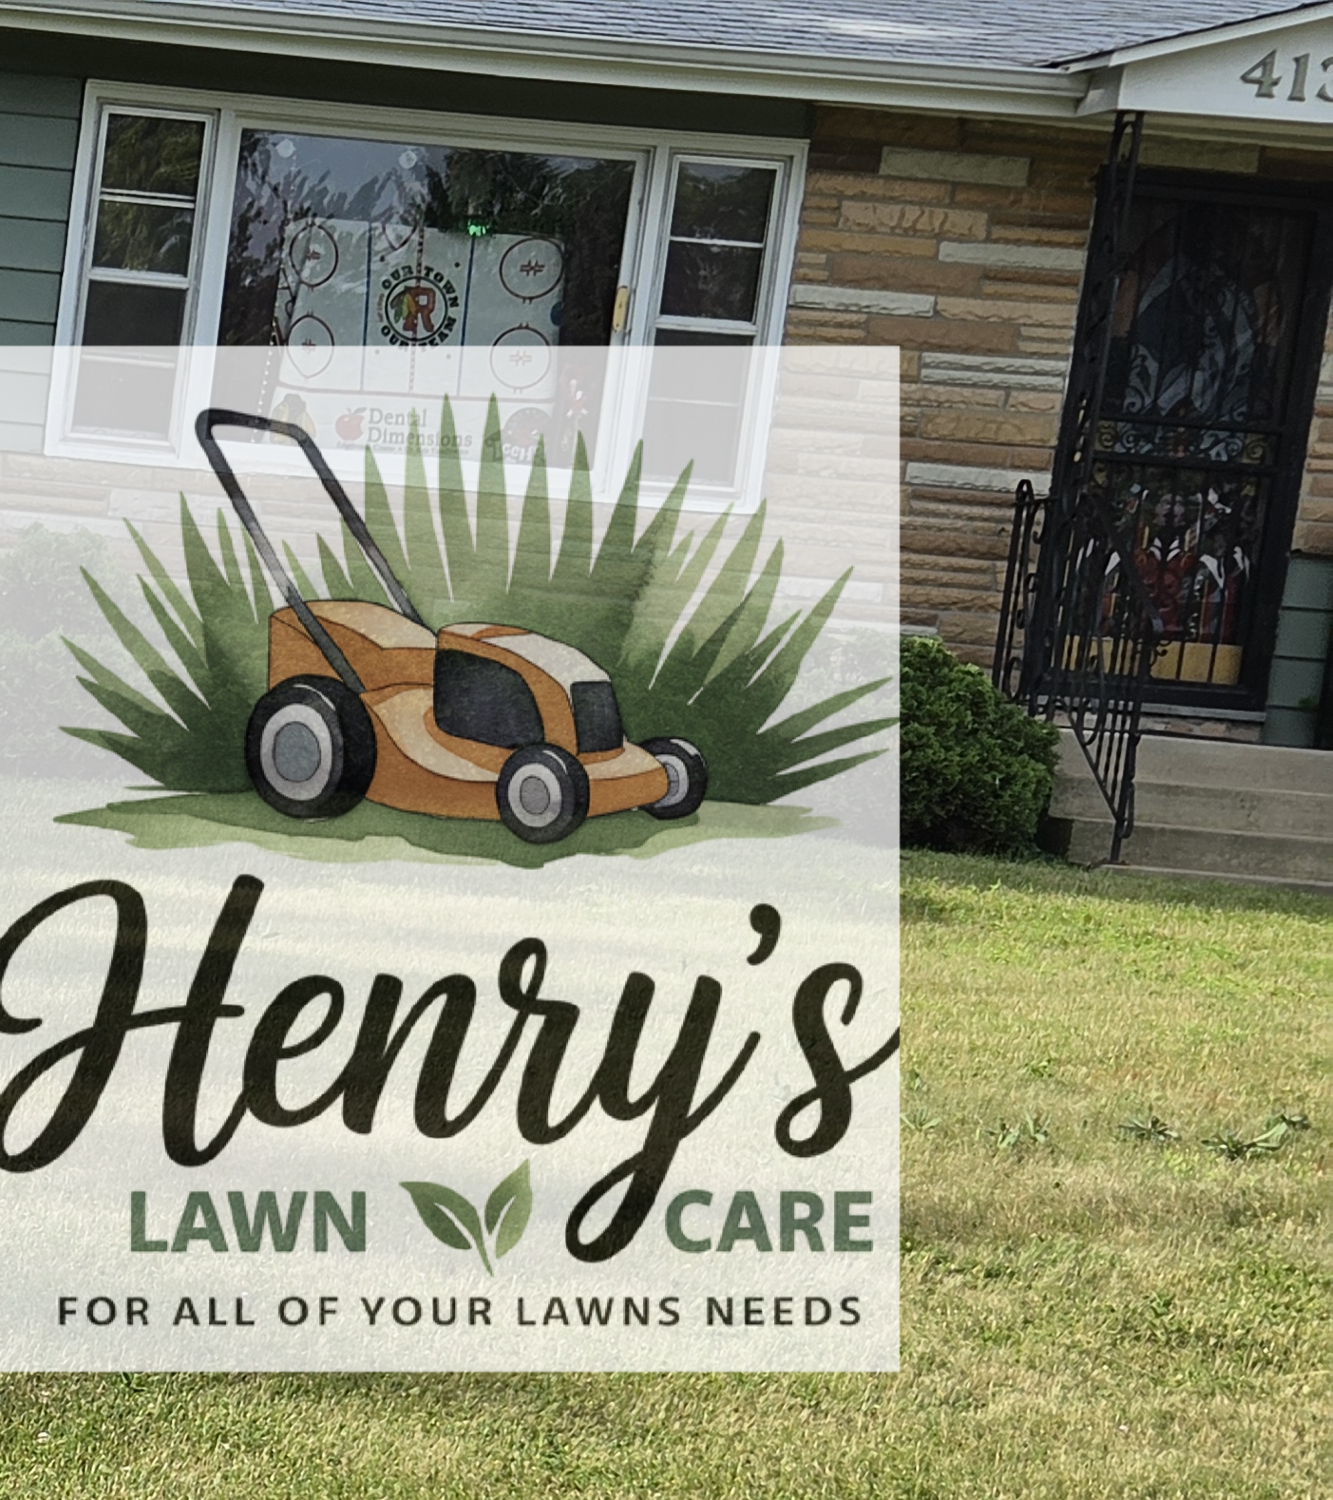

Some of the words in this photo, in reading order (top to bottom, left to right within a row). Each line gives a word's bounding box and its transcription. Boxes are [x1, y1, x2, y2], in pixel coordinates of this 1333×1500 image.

[381, 265, 414, 290] OUR
[424, 266, 459, 308] TOWN
[368, 407, 428, 427] Dental
[367, 427, 473, 447] Dimensions
